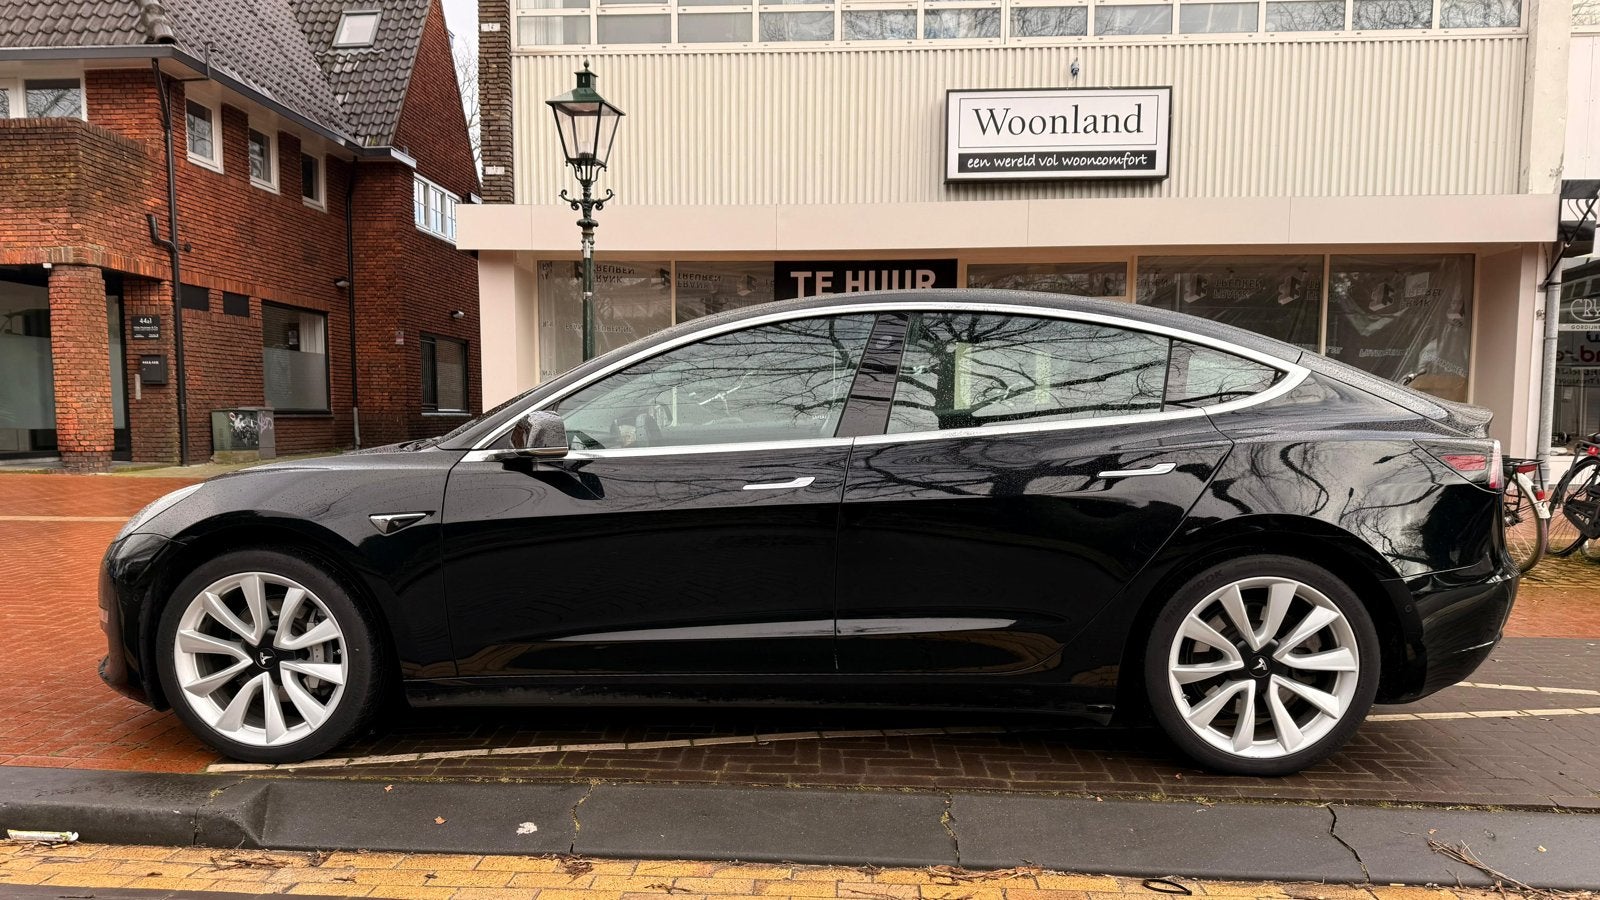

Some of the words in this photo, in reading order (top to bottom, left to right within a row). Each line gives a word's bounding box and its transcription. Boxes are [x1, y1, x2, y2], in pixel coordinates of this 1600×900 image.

[972, 103, 1144, 136] Woonland
[967, 155, 991, 168] een
[993, 153, 1036, 168] wereld
[1038, 153, 1058, 167] vol
[1062, 152, 1148, 169] wooncomfort
[790, 270, 834, 298] TE
[845, 269, 937, 293] HUUR
